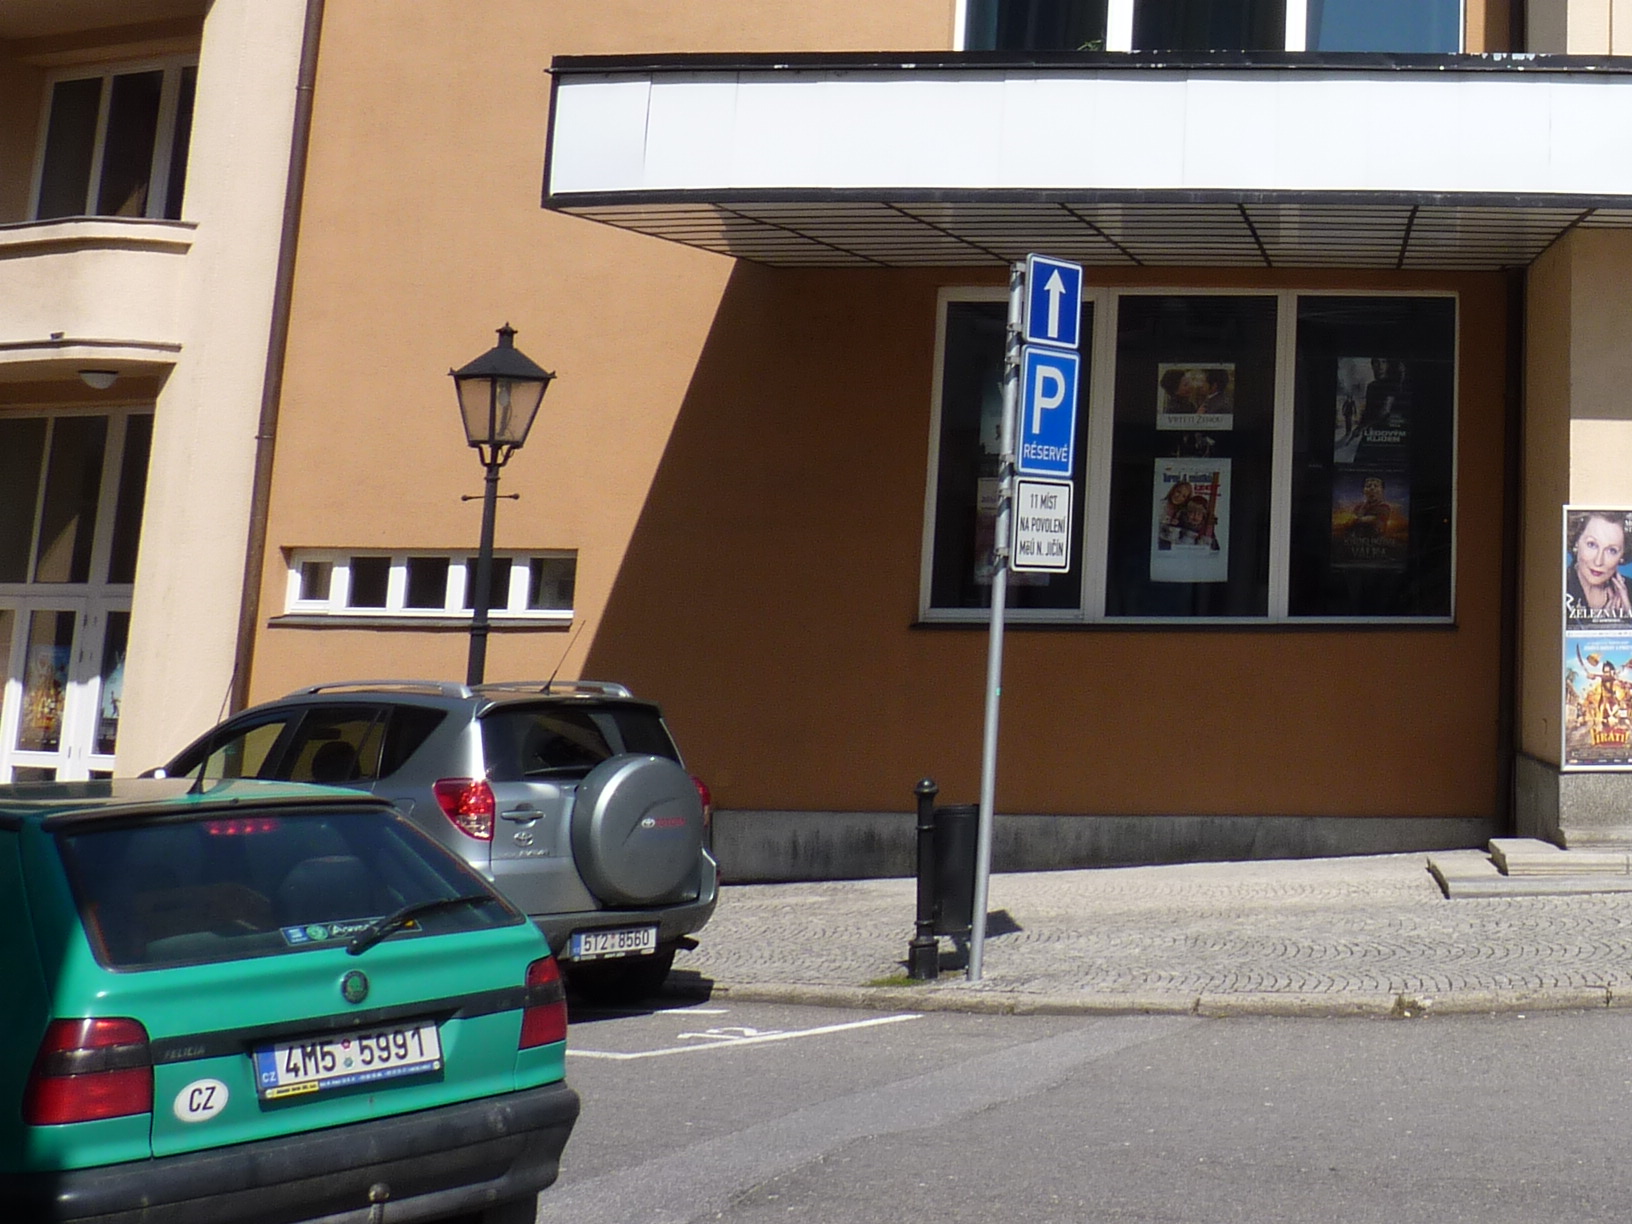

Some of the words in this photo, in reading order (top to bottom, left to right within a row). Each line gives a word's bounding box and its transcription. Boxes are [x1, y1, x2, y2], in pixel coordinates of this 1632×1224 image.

[1032, 365, 1066, 434] P
[1023, 441, 1068, 462] RÉSERVÉ
[1030, 493, 1038, 509] 11
[1040, 491, 1058, 510] MÍST
[1019, 516, 1029, 532] NA
[1031, 516, 1066, 534] POVOLENÍ
[1045, 539, 1064, 557] JIČÍN
[584, 933, 608, 952] 5T2
[618, 929, 650, 949] 8560
[285, 1040, 336, 1078] 4M5
[357, 1027, 425, 1066] 5991
[262, 1071, 277, 1083] CZ
[189, 1085, 217, 1113] CZ
